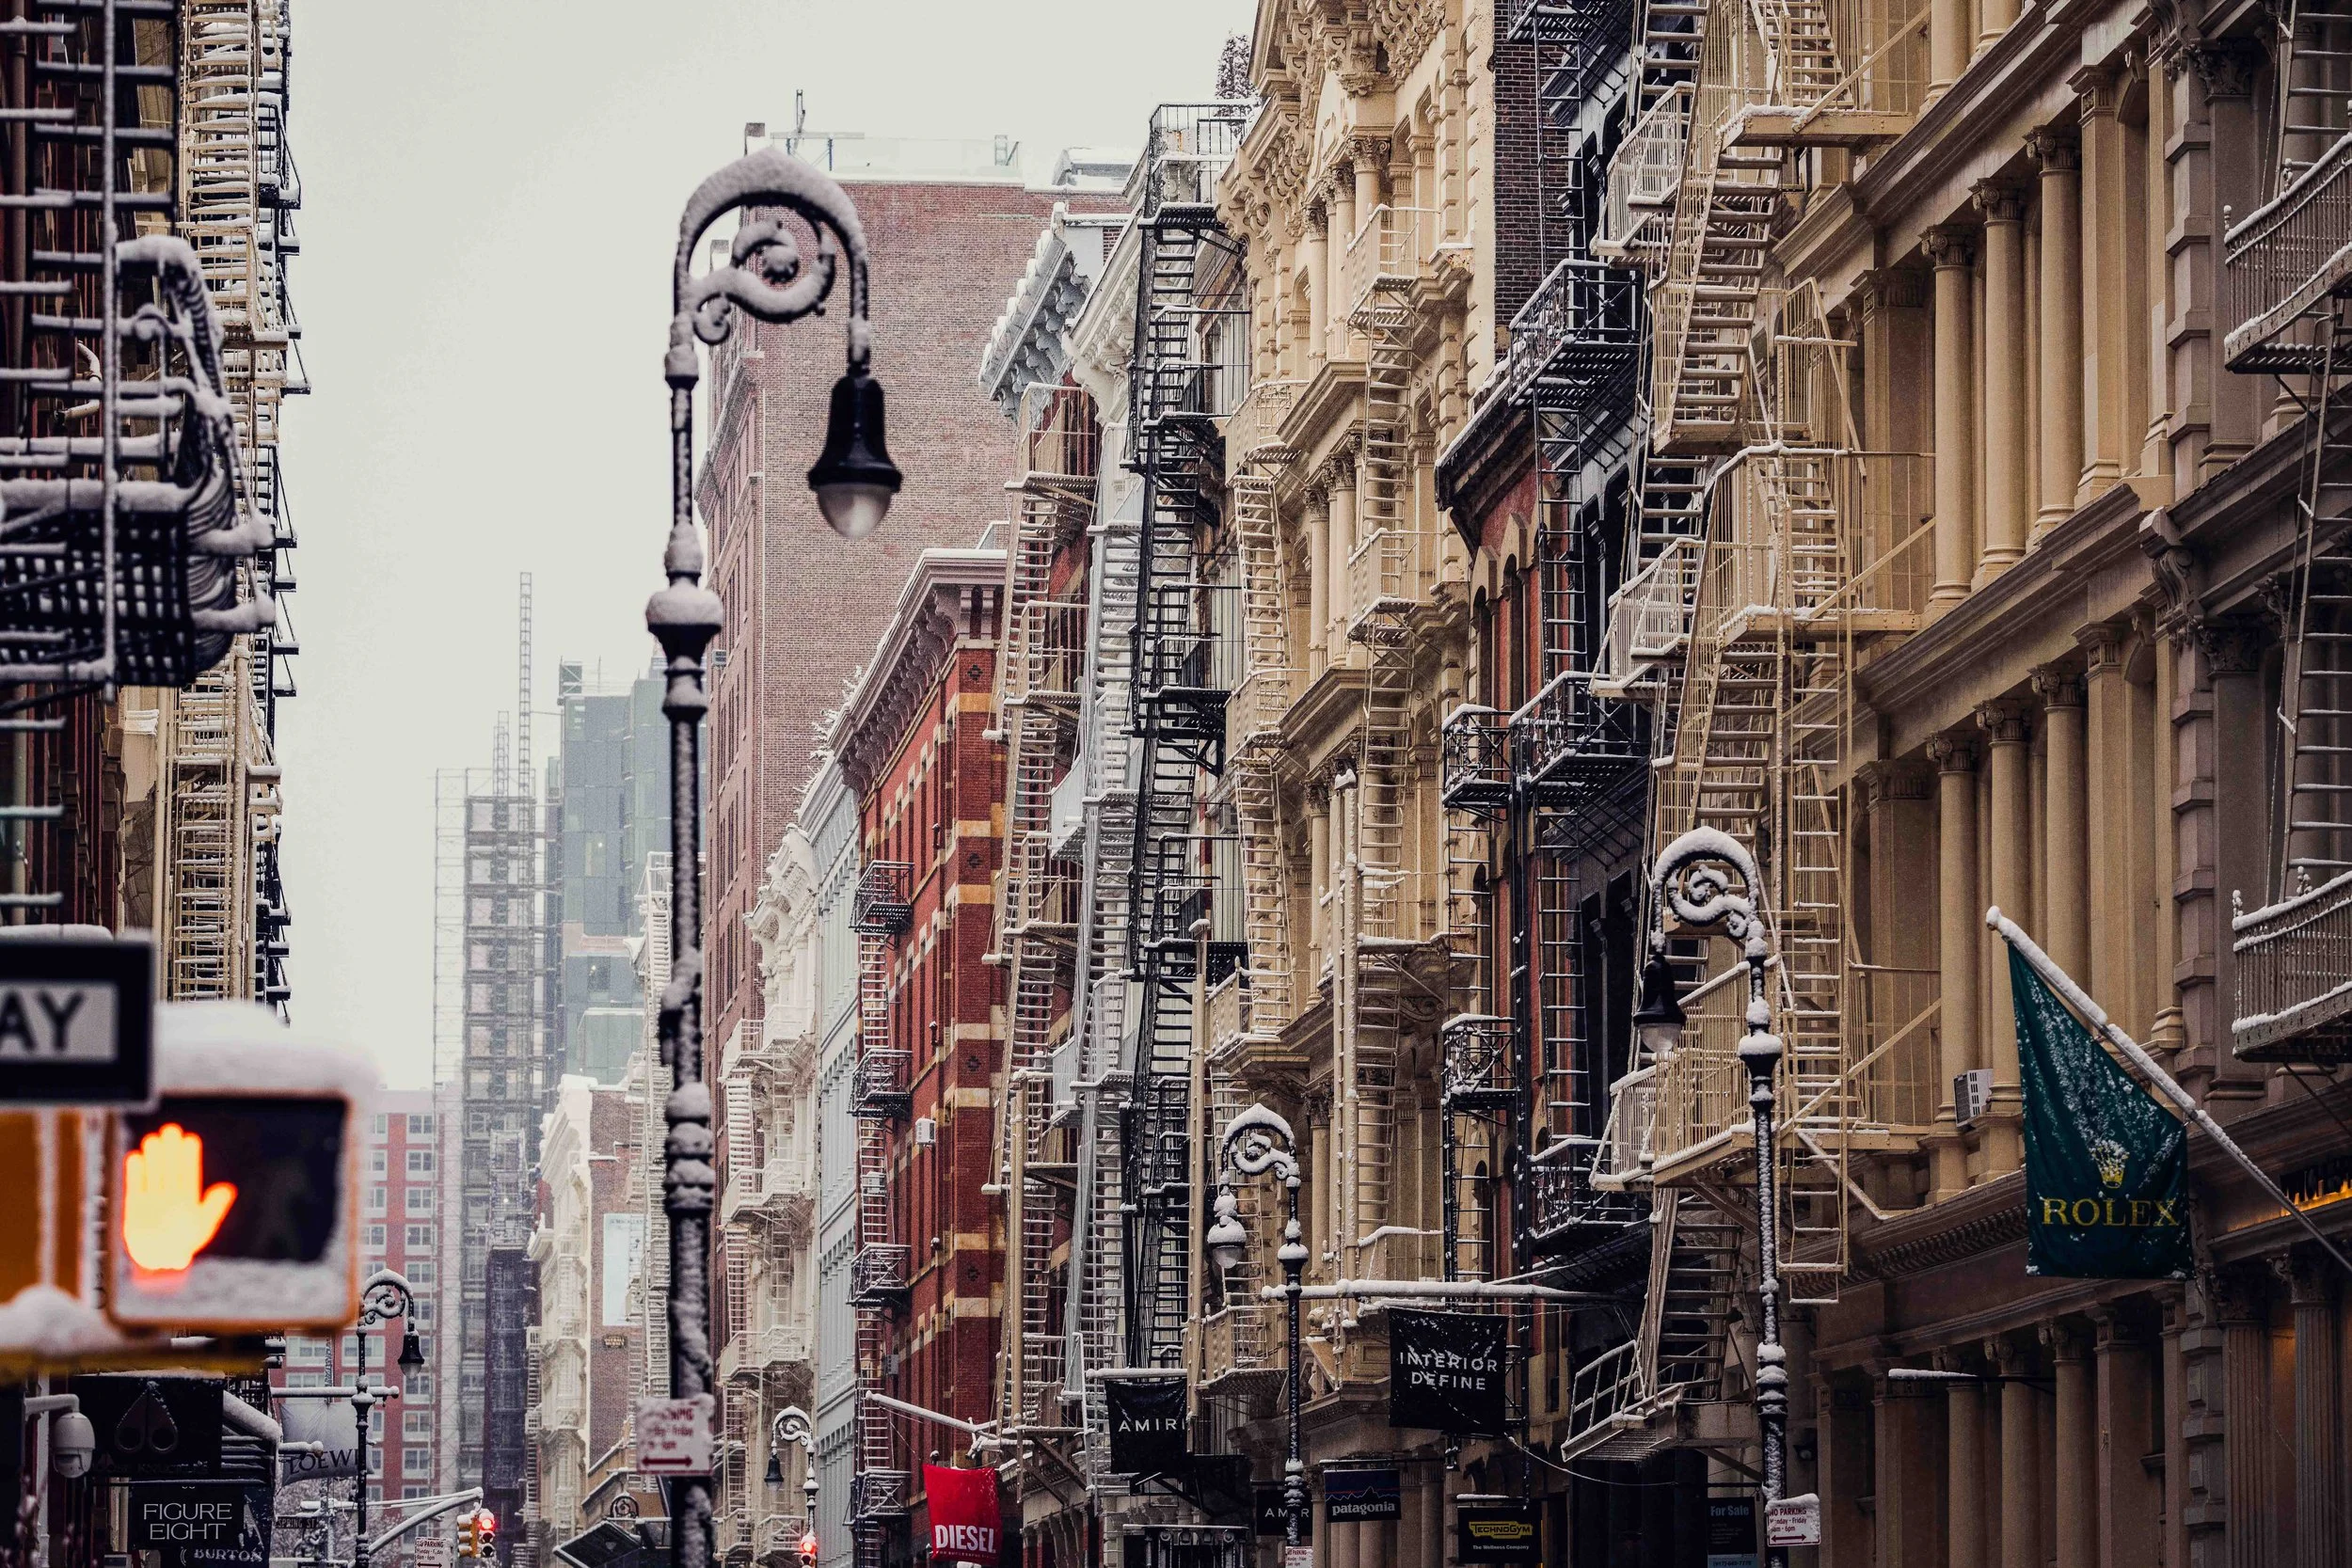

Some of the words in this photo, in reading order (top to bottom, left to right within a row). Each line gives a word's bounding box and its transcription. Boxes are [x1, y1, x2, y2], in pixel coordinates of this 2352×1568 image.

[2042, 1197, 2180, 1227] ROLEX
[1400, 1352, 1497, 1372] INTERIOR
[1412, 1371, 1486, 1390] DEFINE
[1119, 1418, 1185, 1432] AMIRI
[144, 1503, 232, 1520] FIGURE
[1332, 1501, 1396, 1516] patagonia
[1709, 1506, 1725, 1517] For
[1727, 1505, 1750, 1516] Sale
[1769, 1508, 1779, 1516] NO
[1780, 1507, 1807, 1515] PARKING
[278, 1518, 303, 1528] SPRING
[307, 1518, 315, 1528] ST
[1785, 1525, 1796, 1533] 6pm
[150, 1522, 227, 1540] EIGHT
[934, 1525, 996, 1553] DIESEL
[193, 1548, 263, 1562] BURTON
